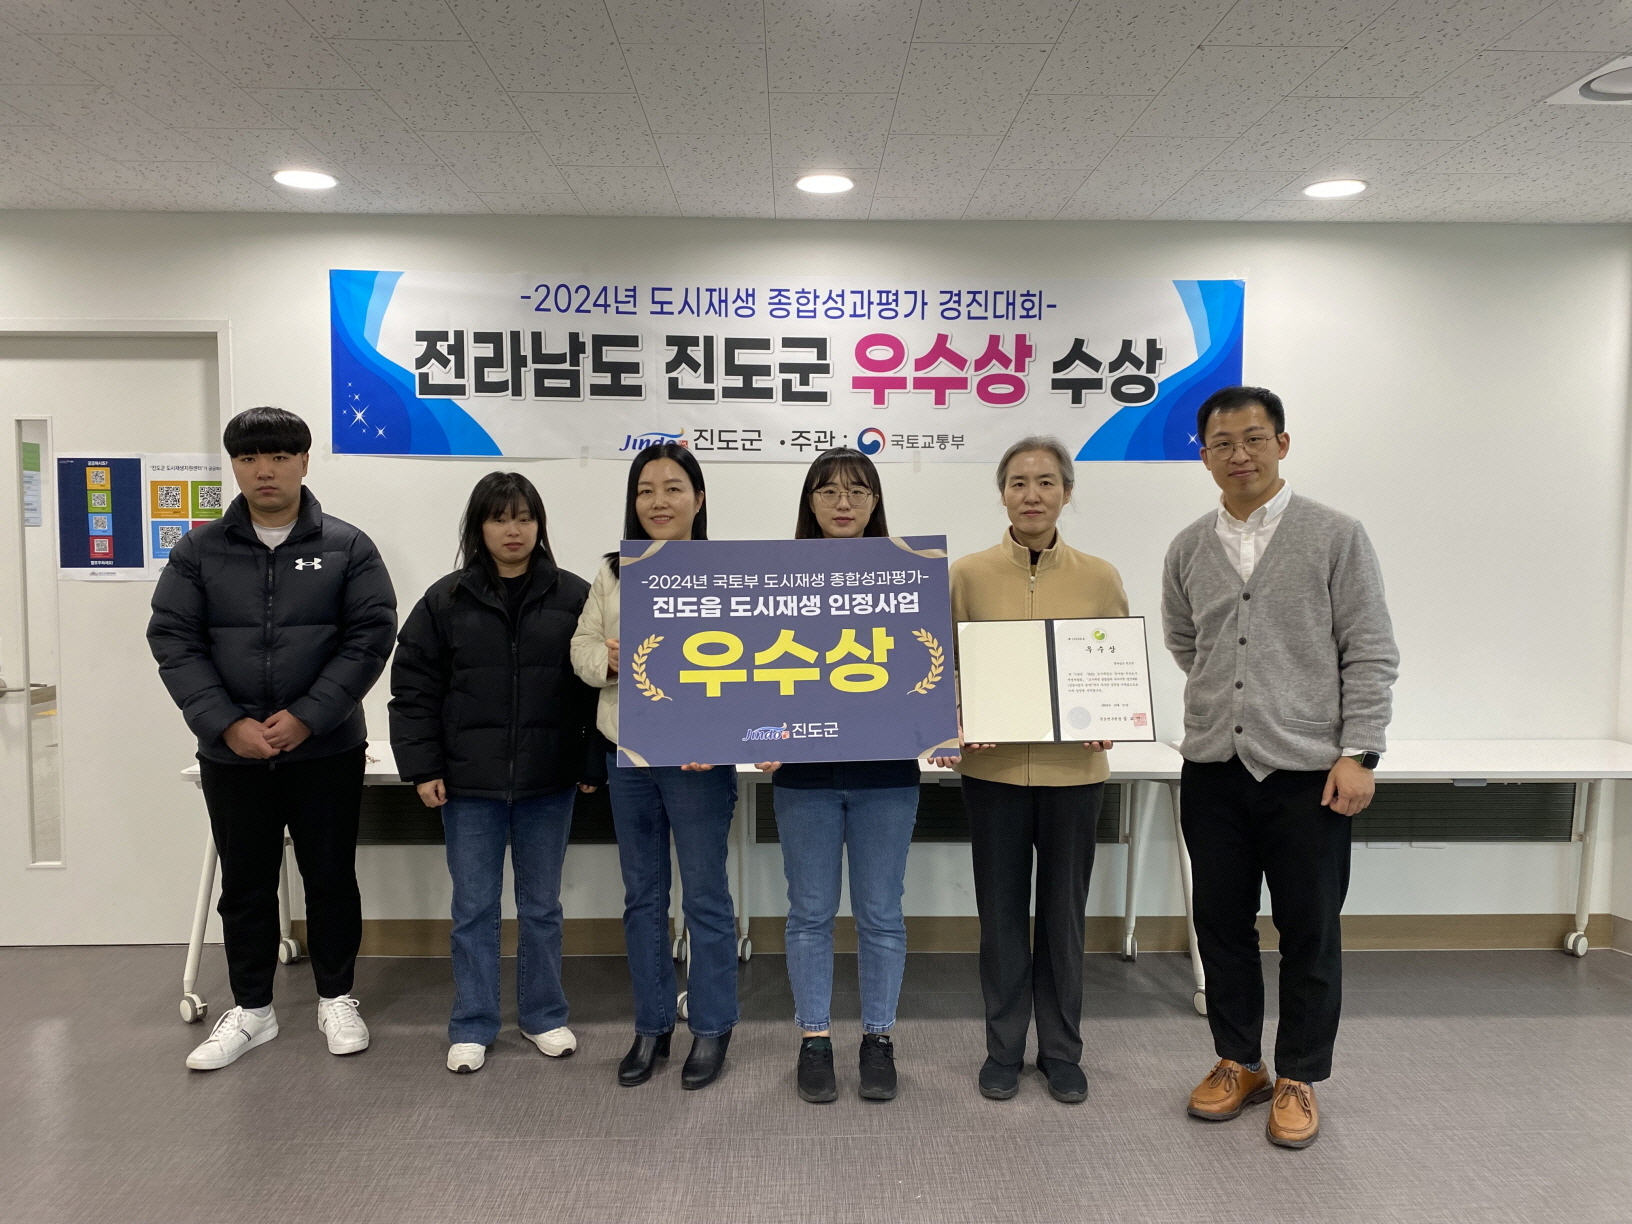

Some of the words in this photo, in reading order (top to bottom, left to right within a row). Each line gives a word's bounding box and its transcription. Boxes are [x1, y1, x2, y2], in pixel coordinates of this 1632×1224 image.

[520, 283, 638, 316] -2024년
[649, 286, 757, 318] 도시재생
[767, 288, 929, 321] 종합성과평가
[939, 289, 1058, 321] 경진대회-
[413, 329, 646, 400] 전라남도
[664, 333, 832, 405] 진도군
[850, 332, 1034, 407] 우수상
[1050, 336, 1165, 407] 수상
[693, 428, 763, 452] 진도군
[890, 434, 965, 450] 국토교통부
[641, 574, 708, 590] -2024년
[712, 573, 759, 590] 국토부
[763, 572, 825, 588] 도시재생
[830, 569, 930, 587] 종합성과평가-
[652, 596, 722, 618] 진도읍
[729, 594, 821, 617] 도시재생
[828, 591, 920, 616] 인정사업
[679, 627, 895, 698] 우수상
[741, 728, 783, 742] Jindo
[792, 722, 839, 739] 진도군
